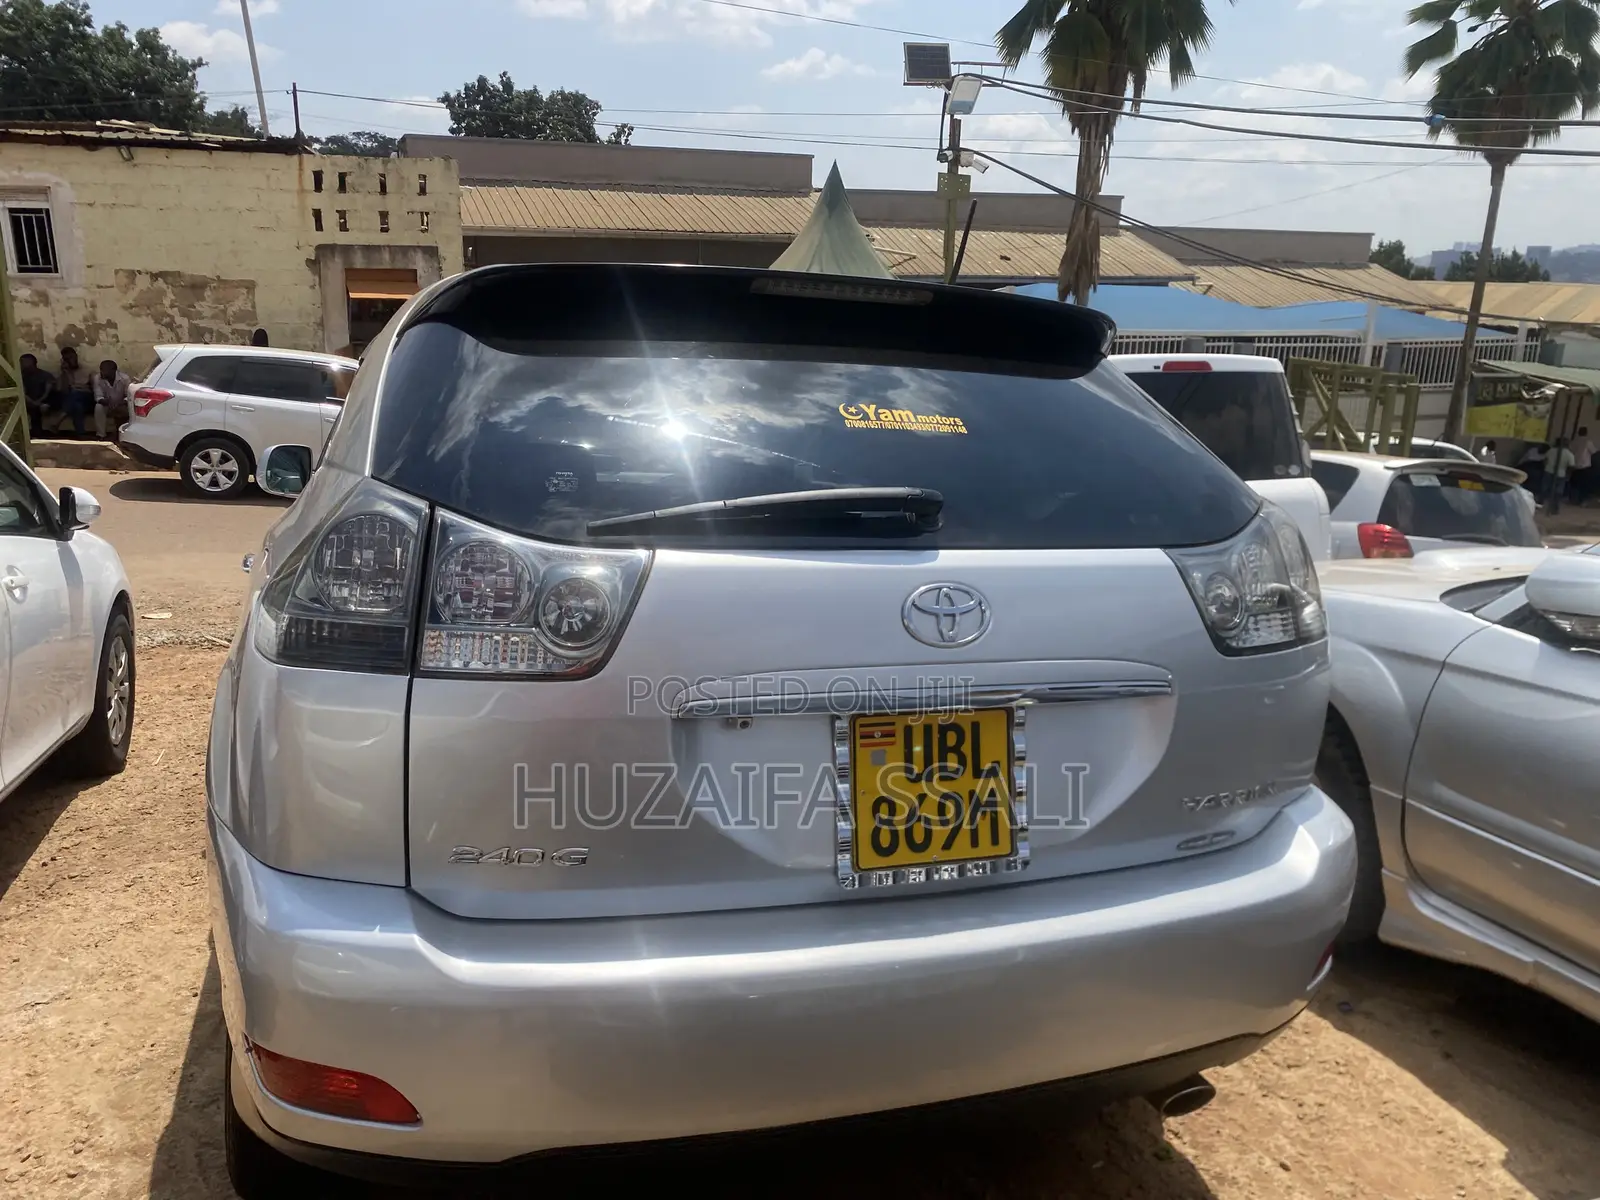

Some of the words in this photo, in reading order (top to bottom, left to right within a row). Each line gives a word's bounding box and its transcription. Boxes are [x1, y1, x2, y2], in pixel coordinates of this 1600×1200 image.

[858, 403, 916, 422] Yam
[917, 414, 964, 426] motors
[903, 721, 1001, 784] UBL
[870, 788, 1001, 858] 869M
[448, 845, 545, 868] 240
[551, 847, 590, 868] G
